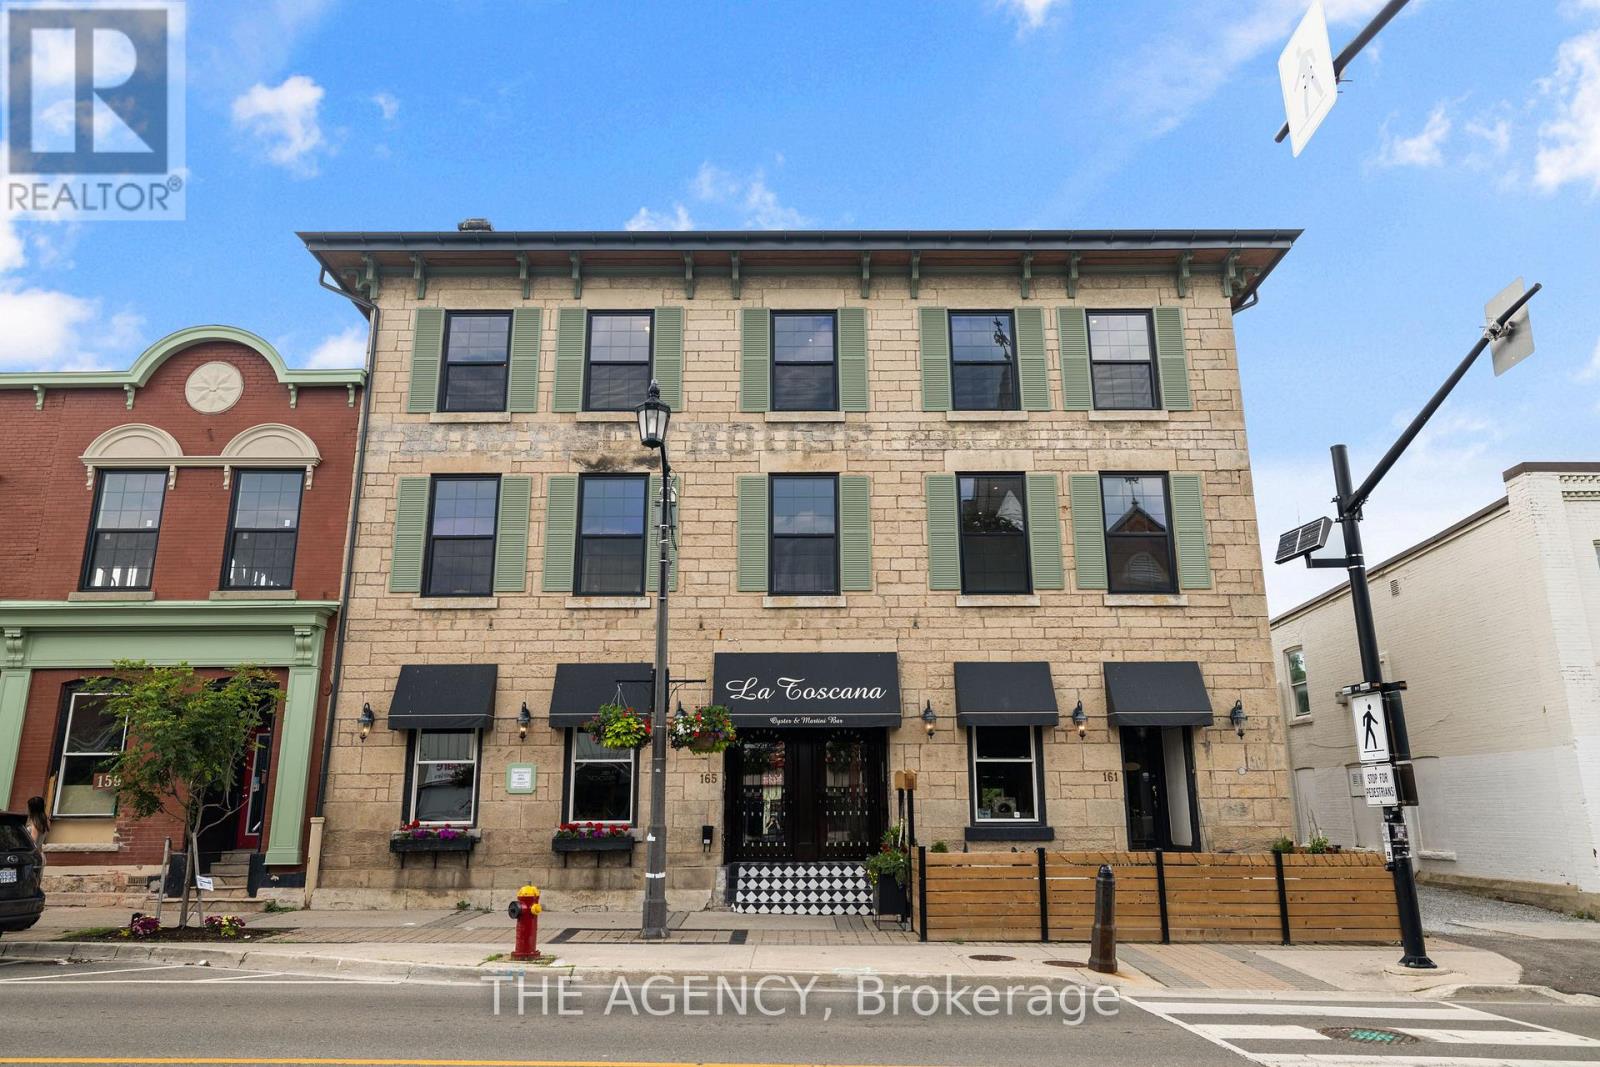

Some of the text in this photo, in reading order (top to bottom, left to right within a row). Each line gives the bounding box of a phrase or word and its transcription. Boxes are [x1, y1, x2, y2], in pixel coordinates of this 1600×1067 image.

[725, 676, 887, 701] La Toscana
[769, 716, 843, 726] Oyster & Martini Bar
[700, 773, 717, 784] 165
[1103, 771, 1118, 782] 161
[1367, 772, 1389, 784] STOP FOR
[1366, 787, 1395, 797] PEDESTRIANS
